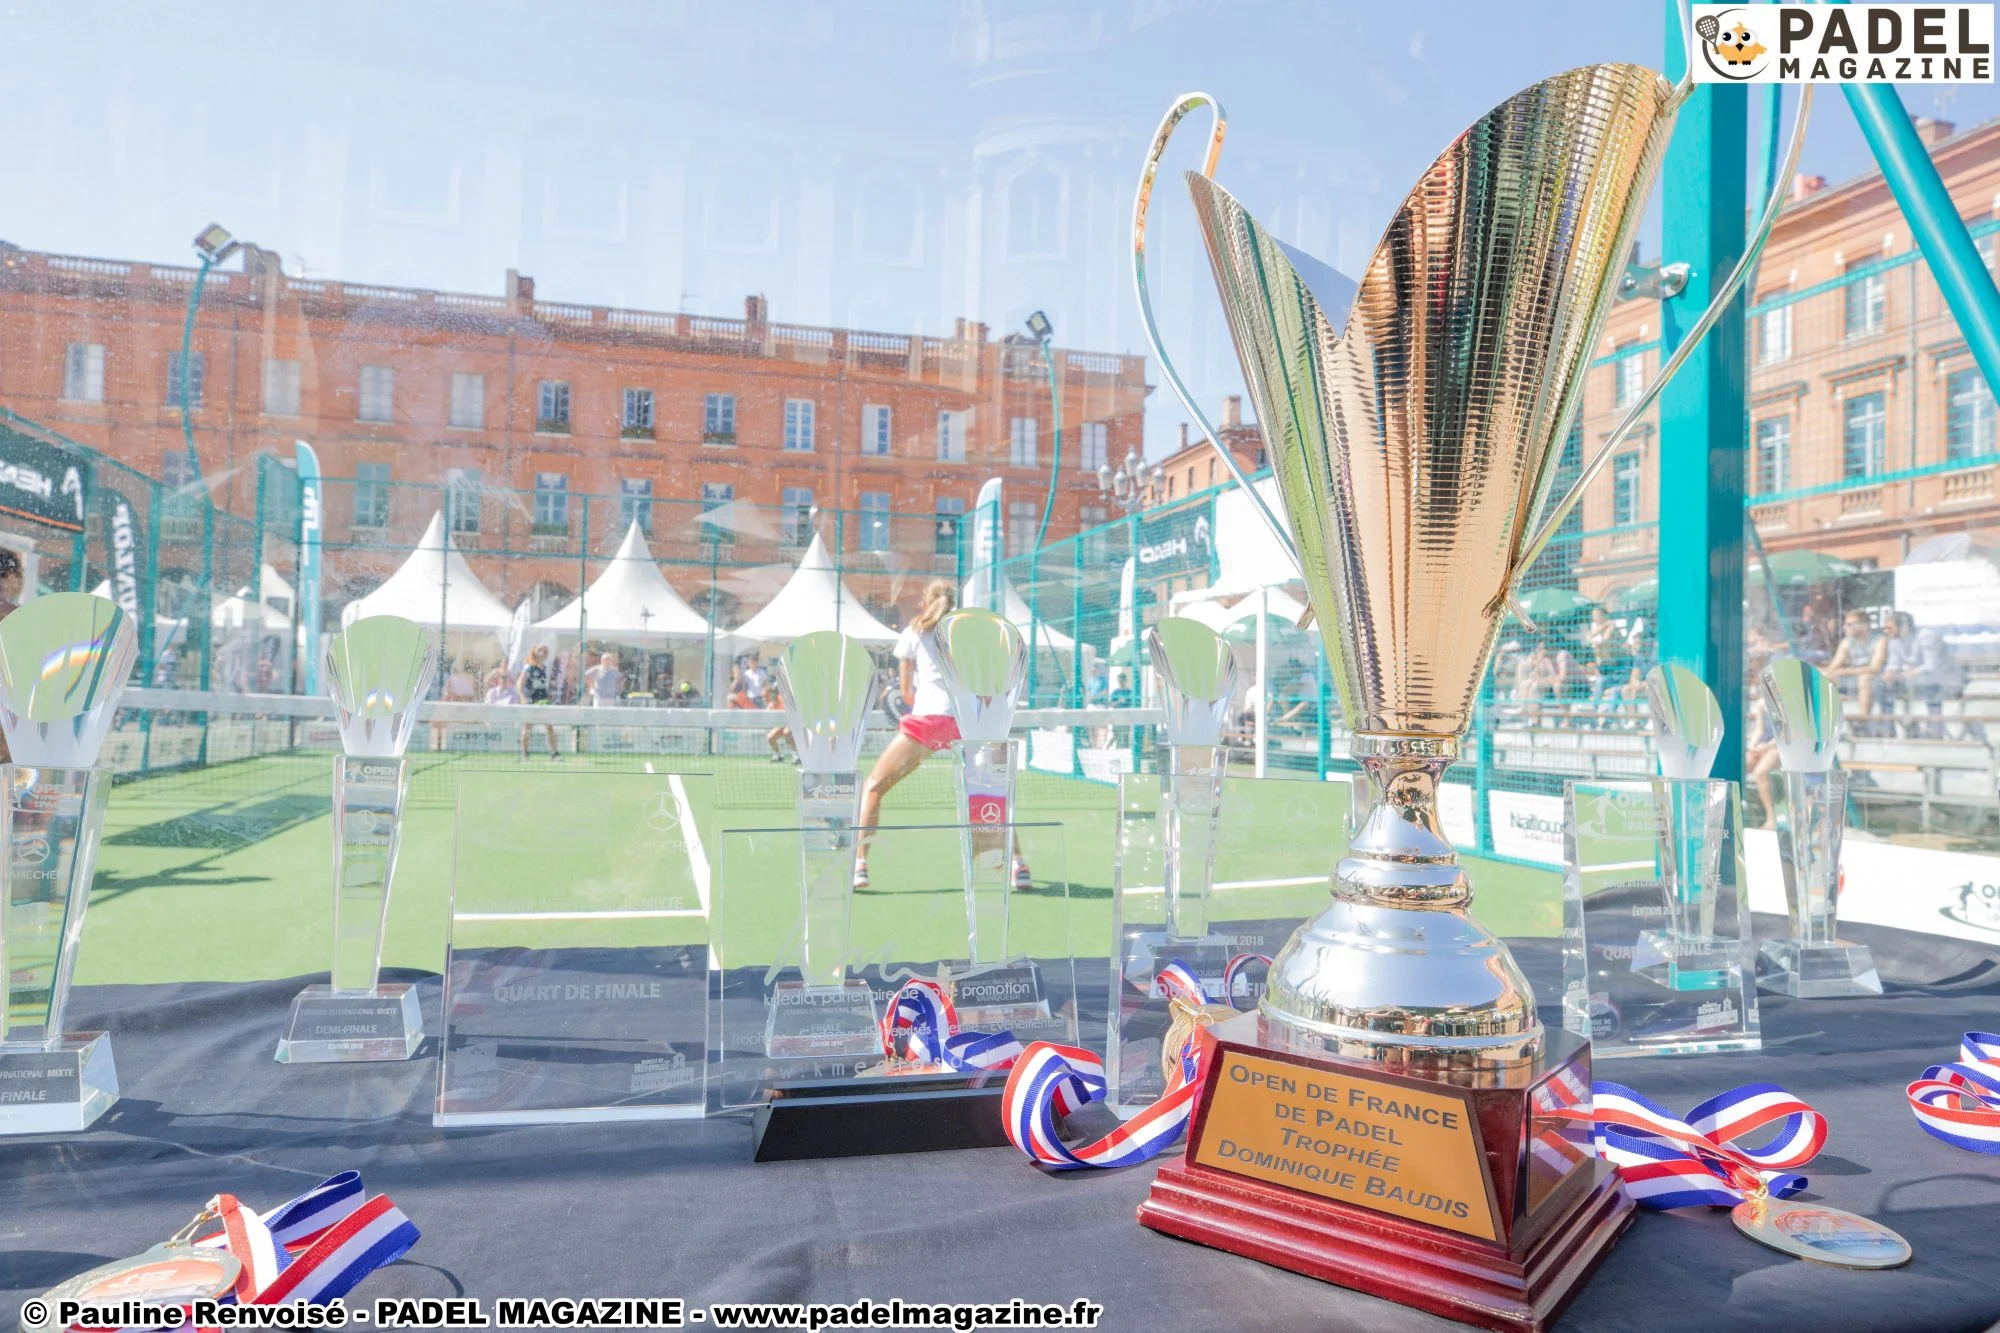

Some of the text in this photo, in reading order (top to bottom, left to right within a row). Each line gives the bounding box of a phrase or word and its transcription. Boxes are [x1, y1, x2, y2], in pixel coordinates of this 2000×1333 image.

[363, 765, 397, 775] OPEN
[824, 784, 855, 793] OPEN
[1240, 934, 1265, 946] 2018
[493, 982, 662, 1003] QUART DE FINALE
[900, 986, 919, 999] de
[961, 982, 1030, 999] promotion
[315, 1024, 378, 1035] DEMI-FINALE
[46, 1067, 75, 1078] MIXTE
[1, 1089, 48, 1102] FINALE
[1229, 1063, 1459, 1130] OPEN DE FRANCE
[1275, 1102, 1403, 1146] DE PADEL
[1280, 1127, 1401, 1173] TROPHÉE
[1217, 1138, 1471, 1219] DOMINIQUE BAUDIS
